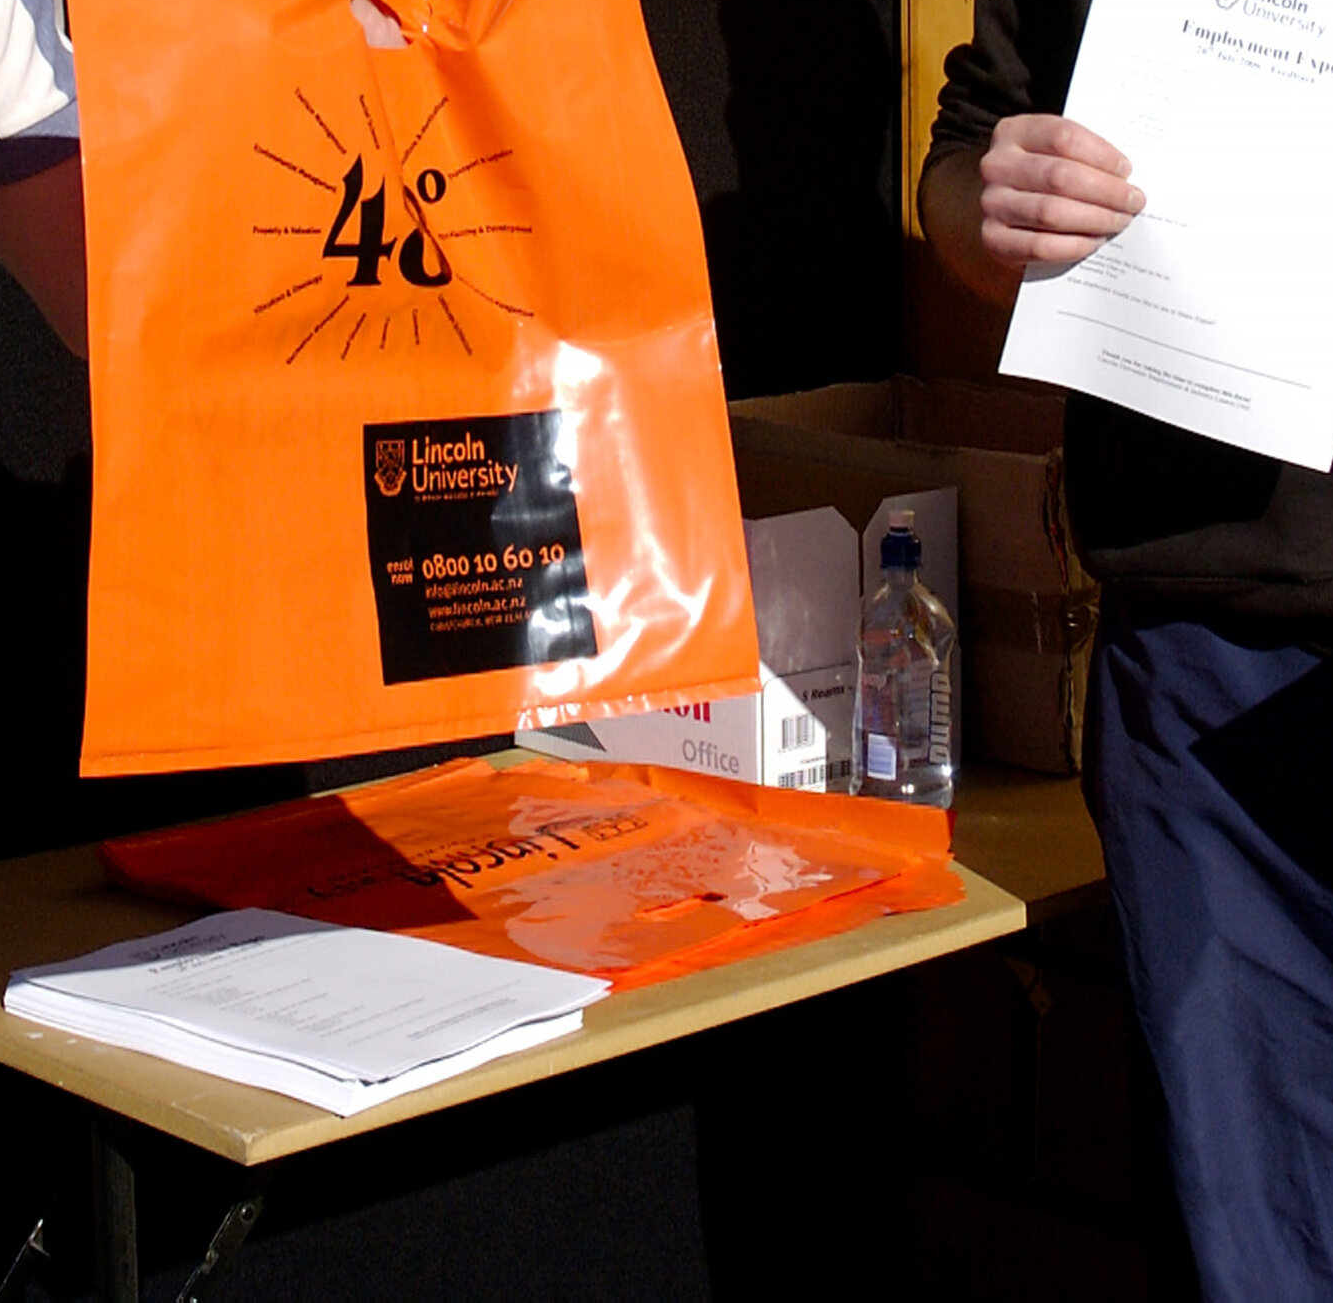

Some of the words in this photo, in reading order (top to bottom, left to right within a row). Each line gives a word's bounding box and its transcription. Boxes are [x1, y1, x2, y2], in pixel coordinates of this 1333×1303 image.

[1182, 19, 1290, 61] Employment
[411, 431, 486, 465] Lincoln
[411, 459, 519, 494] University
[422, 553, 470, 580] 0800
[473, 553, 498, 575] 10
[502, 542, 534, 572] 60
[538, 542, 565, 566] 10
[425, 577, 524, 600] info@lincoln.ac.nz
[428, 595, 527, 619] www.lincoln.ac.nz
[810, 685, 845, 701] Reams
[682, 738, 739, 774] Office
